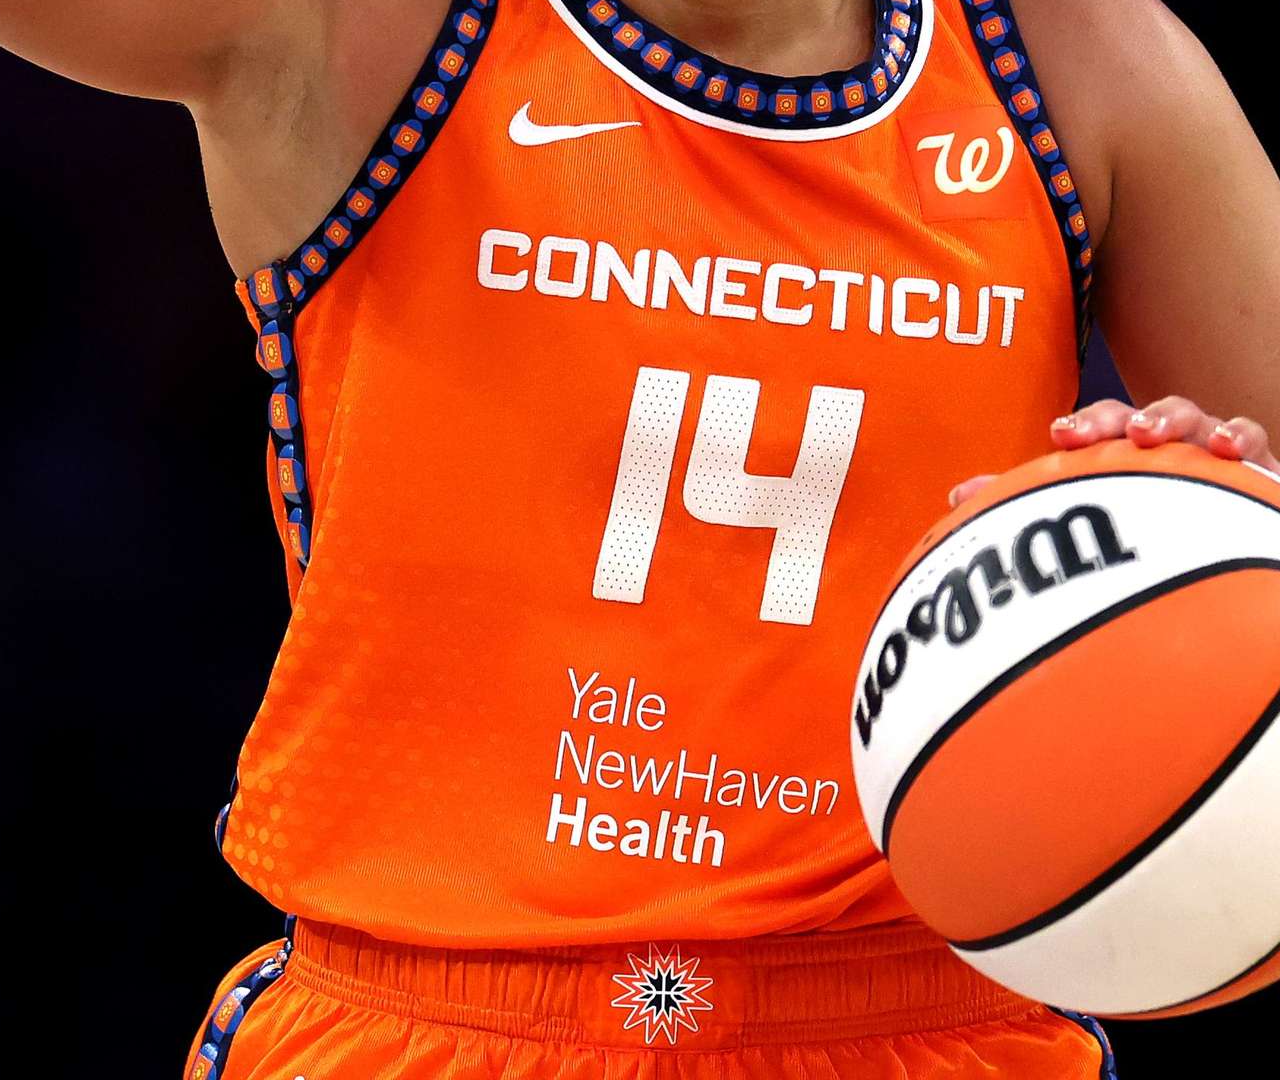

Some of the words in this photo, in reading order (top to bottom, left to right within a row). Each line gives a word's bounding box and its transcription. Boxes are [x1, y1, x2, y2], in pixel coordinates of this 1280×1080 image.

[477, 228, 1025, 347] CONNECTICUT
[592, 366, 865, 626] 14
[854, 503, 1137, 748] Wilson
[567, 667, 666, 731] Yale
[554, 730, 840, 816] NewHaven
[546, 793, 725, 867] Health
